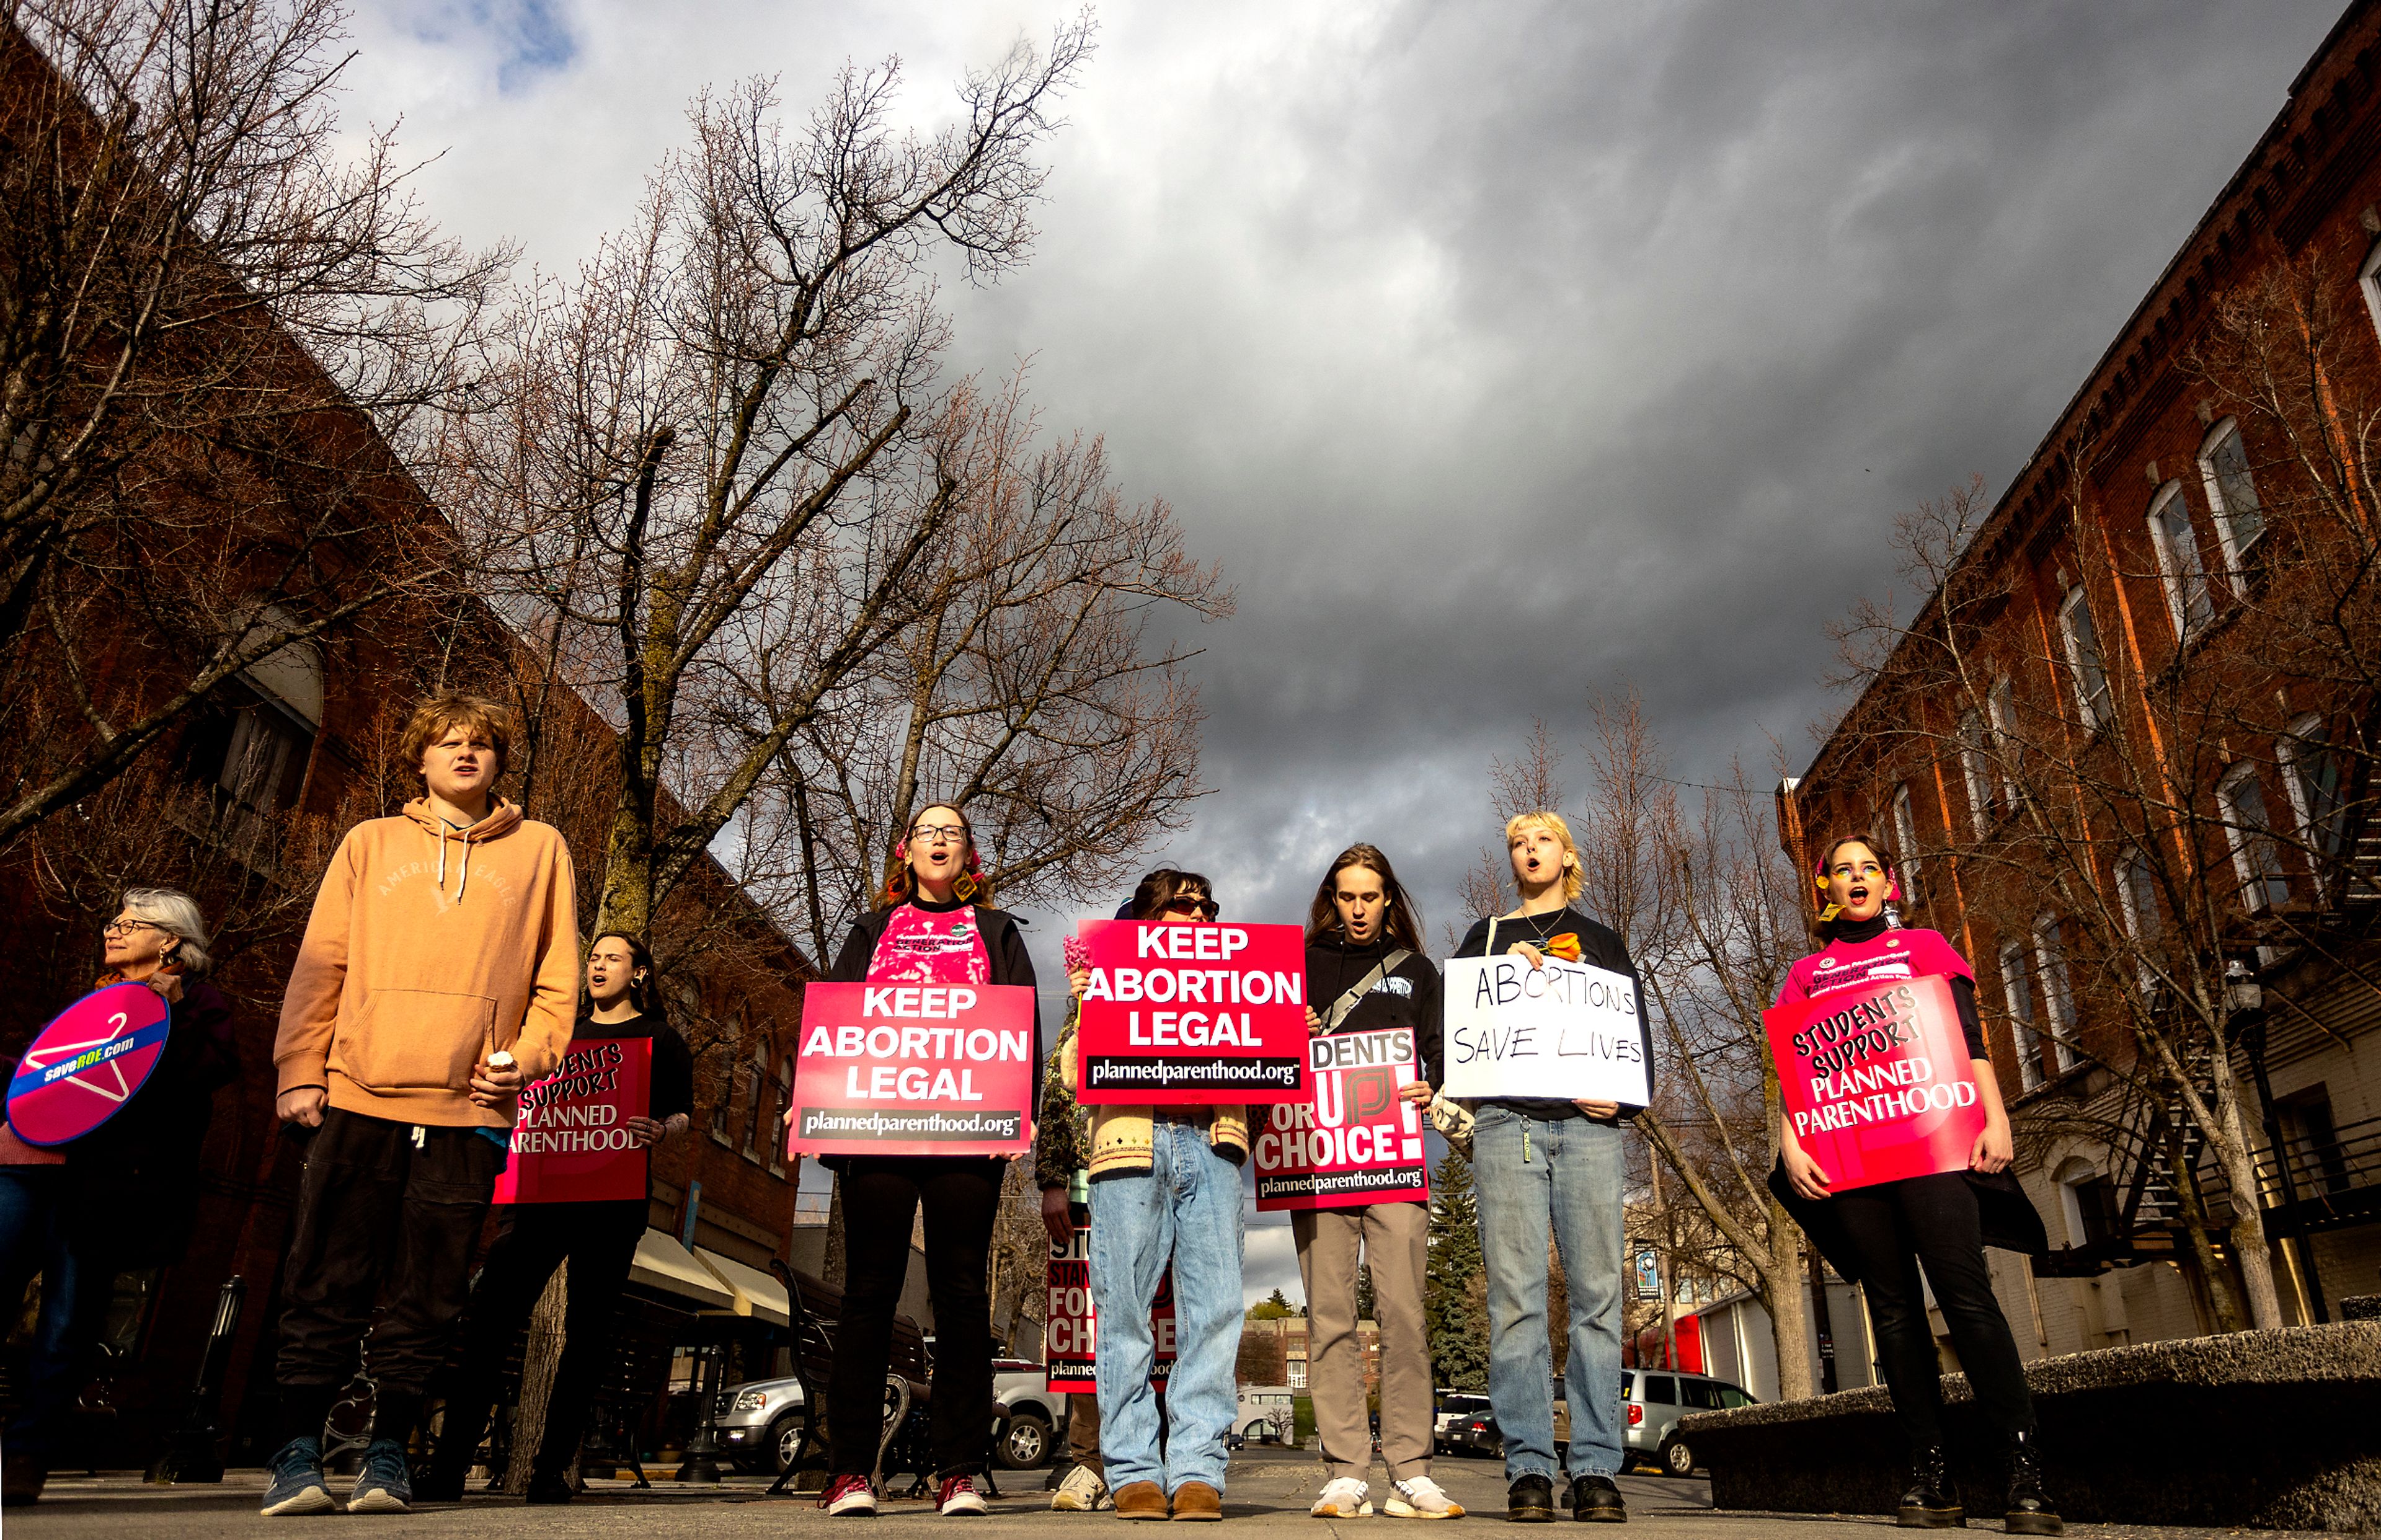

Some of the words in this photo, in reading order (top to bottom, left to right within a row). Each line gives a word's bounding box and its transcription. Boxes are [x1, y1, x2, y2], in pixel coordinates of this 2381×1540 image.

[474, 864, 516, 907] EAGLE
[896, 937, 974, 945] GENERATION
[1138, 926, 1249, 960] KEEP
[1082, 968, 1301, 1004] ABORTION
[1812, 970, 1866, 992] ACTION
[1814, 957, 1910, 985] GENERATION
[863, 988, 977, 1019] KEEP
[1476, 964, 1635, 1014] ABORTIONS
[1129, 1011, 1263, 1047] LEGAL
[1793, 986, 1917, 1056] STUDENTS
[44, 1037, 134, 1082] saveROE.com
[802, 1025, 1028, 1061] ABORTION
[1313, 1032, 1413, 1068] DENTS
[1454, 1027, 1538, 1063] SAVE
[1558, 1029, 1641, 1062] LIVES
[1812, 1015, 1920, 1079] SUPPORT
[520, 1068, 618, 1110] SUPPORT
[846, 1066, 983, 1101] LEGAL
[1093, 1060, 1295, 1085] plannedparenthood.org
[1811, 1057, 1933, 1104] PLANNED
[515, 1105, 618, 1129] PLANNED
[805, 1111, 1014, 1136] plannedparenthood.org
[1272, 1102, 1315, 1131] OR
[1794, 1081, 1977, 1138] PARENTHOOD
[508, 1128, 644, 1154] ARENTHOOD
[1261, 1168, 1421, 1198] plannedparenthood.org
[1050, 1262, 1090, 1286] STAN
